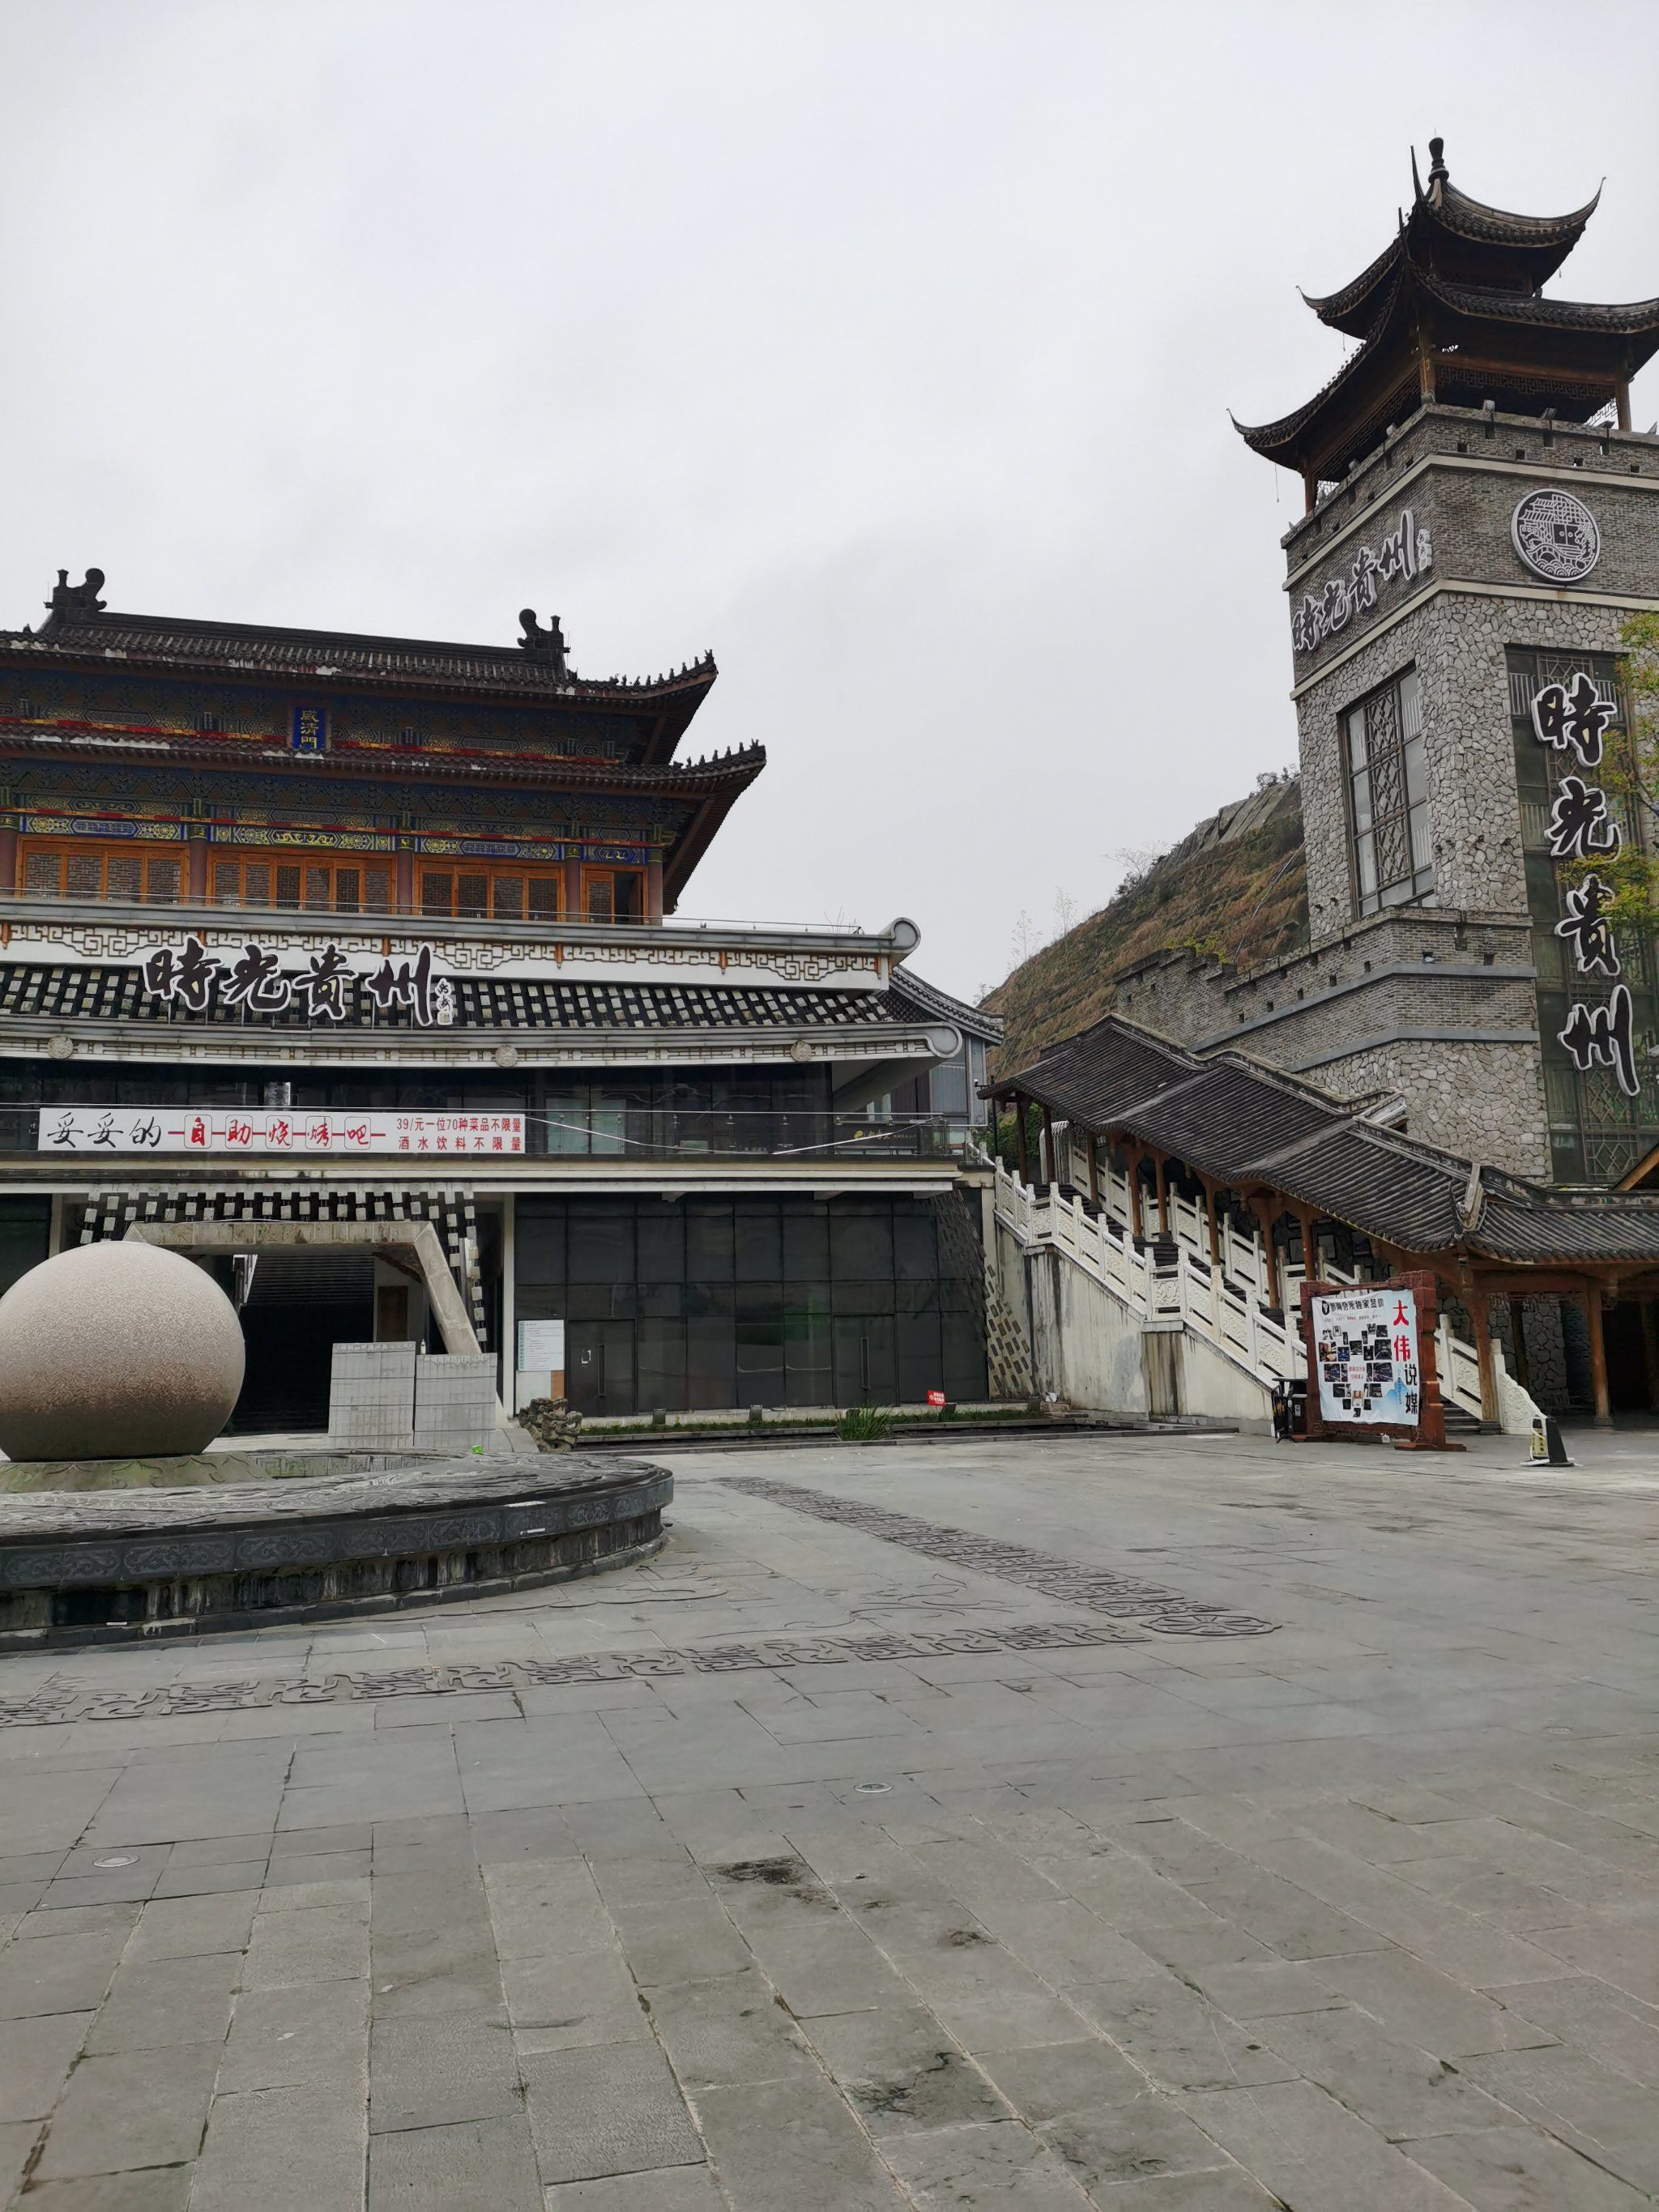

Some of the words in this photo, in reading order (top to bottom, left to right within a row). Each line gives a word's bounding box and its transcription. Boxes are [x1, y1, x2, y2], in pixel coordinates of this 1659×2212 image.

[47, 1112, 162, 1148] 妥妥的
[191, 1116, 369, 1147] 自助烧烤吧
[396, 1118, 522, 1132] 39/元一位70种菜品不限量
[399, 1136, 522, 1151] 酒水饮料不限量
